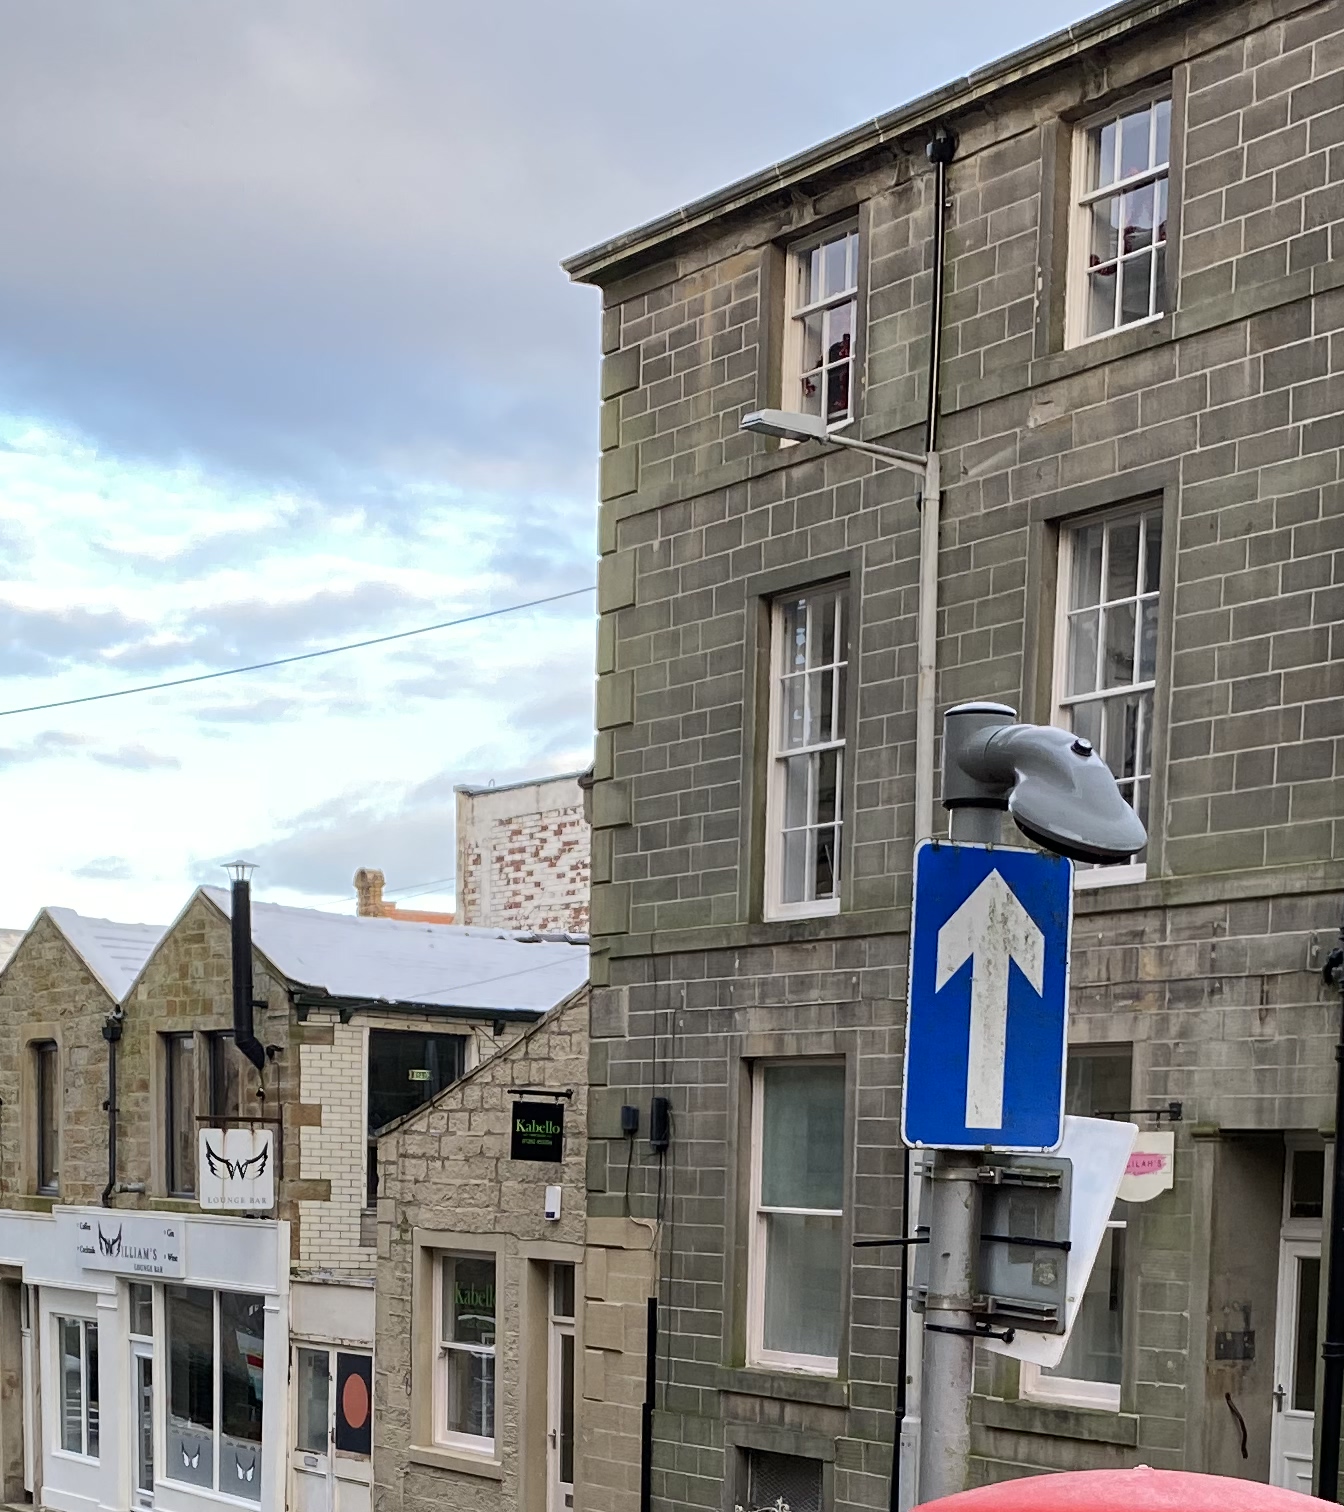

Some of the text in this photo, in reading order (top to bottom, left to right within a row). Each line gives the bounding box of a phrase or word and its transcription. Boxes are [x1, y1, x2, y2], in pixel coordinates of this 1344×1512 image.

[516, 1118, 561, 1134] Kabello
[207, 1196, 267, 1204] LOUNGE BAR
